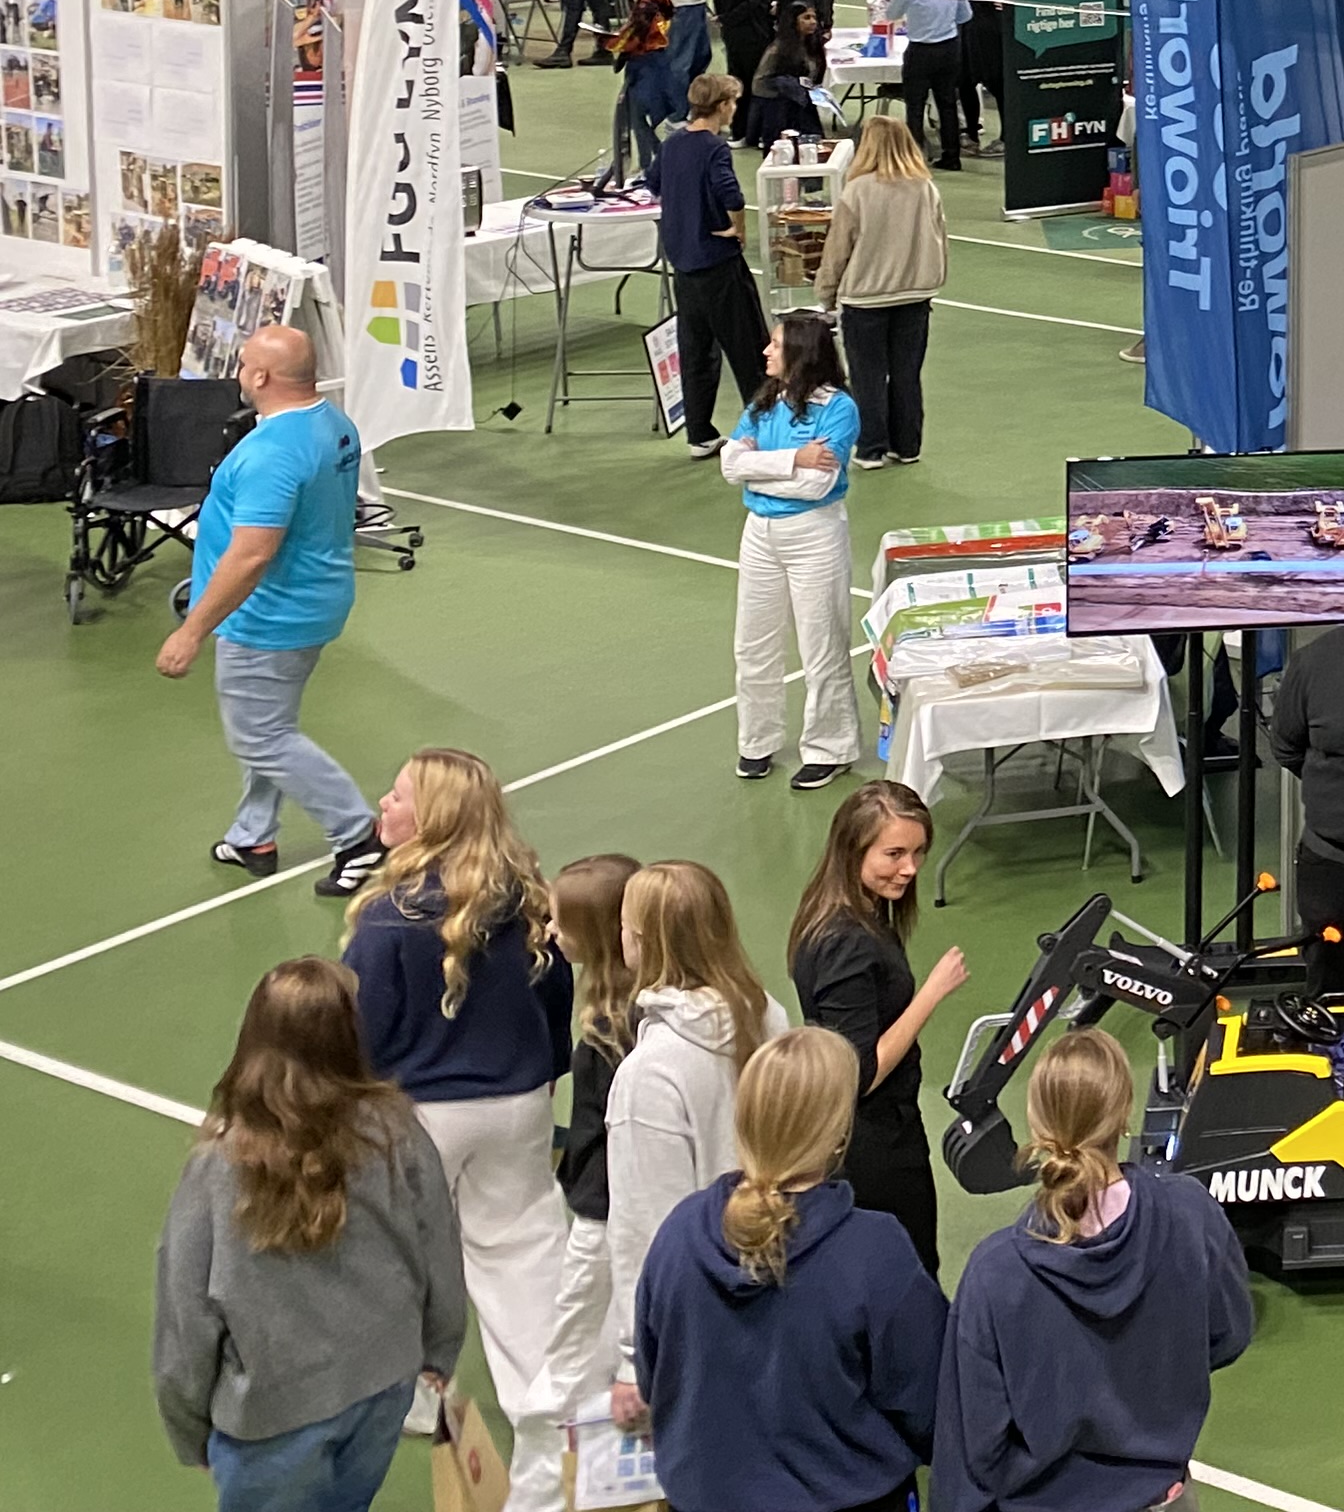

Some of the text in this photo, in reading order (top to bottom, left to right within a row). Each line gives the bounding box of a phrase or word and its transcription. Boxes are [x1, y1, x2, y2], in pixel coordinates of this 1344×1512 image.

[1026, 18, 1076, 32] rigtige her
[420, 57, 443, 121] Nyborg
[1032, 120, 1106, 142] FH FYN
[422, 334, 444, 392] Assens
[1102, 968, 1174, 1006] VOLVO
[1208, 1165, 1327, 1203] MUNCK
